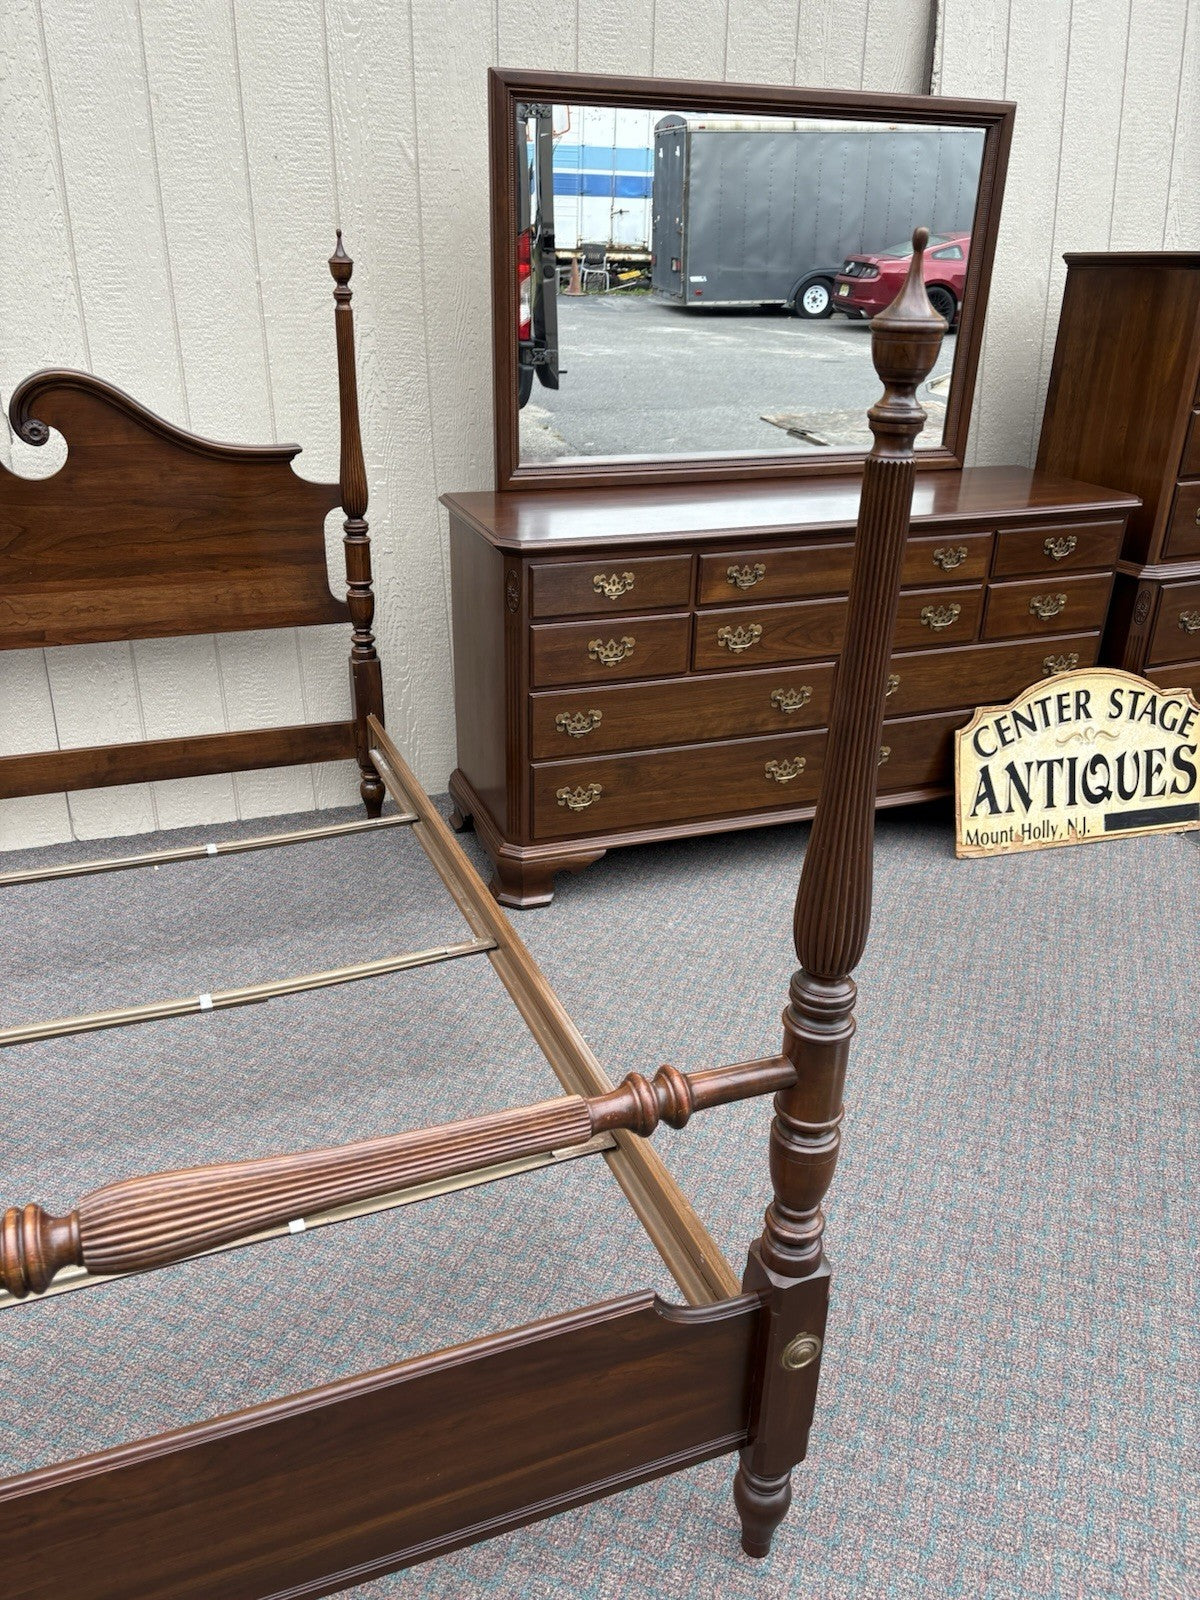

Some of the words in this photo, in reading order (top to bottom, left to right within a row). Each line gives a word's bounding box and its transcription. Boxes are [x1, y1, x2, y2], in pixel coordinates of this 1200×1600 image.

[973, 689, 1092, 757] CENTER
[1108, 688, 1199, 738] STAGE
[970, 743, 1198, 817] ANTIQUES
[966, 825, 1014, 846] Mount
[1021, 819, 1064, 840] Holly,
[1067, 816, 1091, 836] N.J.
